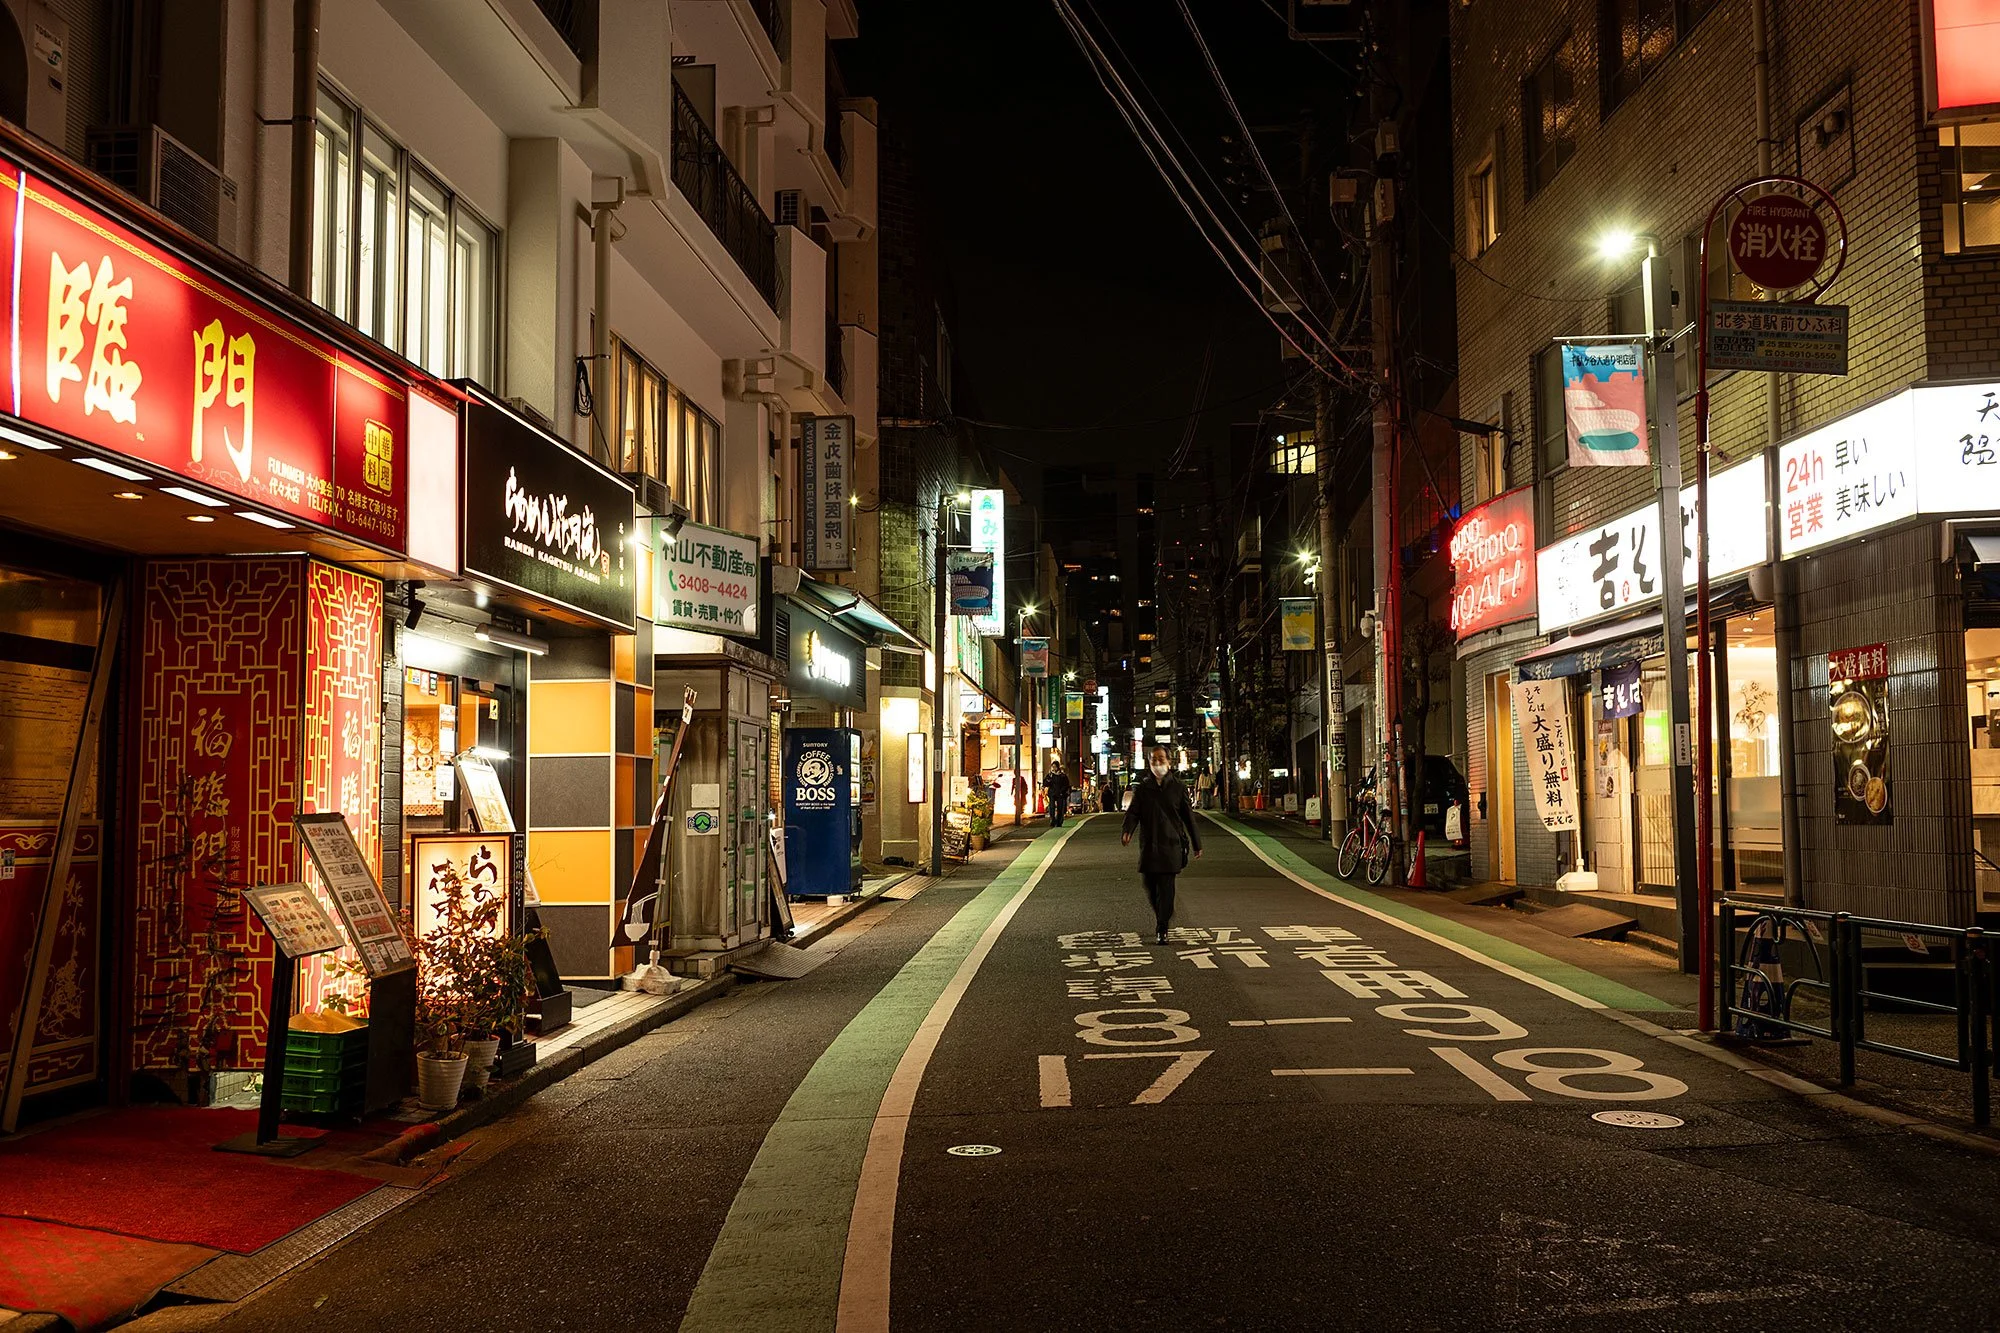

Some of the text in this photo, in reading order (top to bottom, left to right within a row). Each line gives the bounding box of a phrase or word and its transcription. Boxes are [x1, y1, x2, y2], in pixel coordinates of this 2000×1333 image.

[1747, 205, 1811, 219] FIRE HYDRANT
[1739, 222, 1819, 261] 消火栓
[1716, 313, 1842, 333] 北参道駅前ひふ科
[1774, 349, 1837, 360] 03-6910-5550
[1786, 450, 1824, 494] 24h
[1834, 438, 1868, 474] 早い
[306, 472, 334, 499] 大小宴会
[335, 485, 345, 501] 70
[1836, 471, 1906, 522] 美味しい
[269, 477, 301, 505] 代々木店
[345, 508, 396, 538] 03-6447-1953
[1787, 492, 1824, 541] 営業
[504, 535, 535, 558] RAMEN
[538, 550, 573, 574] KAGETSU
[662, 538, 757, 578] 村山不動産(有)
[1466, 523, 1518, 573] STUDIO
[678, 574, 748, 601] 3408-4424
[1450, 559, 1521, 630] NOAH
[672, 599, 744, 626] 賃貸・売買・仲介
[1831, 648, 1885, 682] 大盛無料
[800, 750, 831, 762] COFFEE
[1532, 714, 1564, 808] 大盛り無料
[1553, 719, 1568, 766] こだわりの
[795, 787, 836, 801] BOSS
